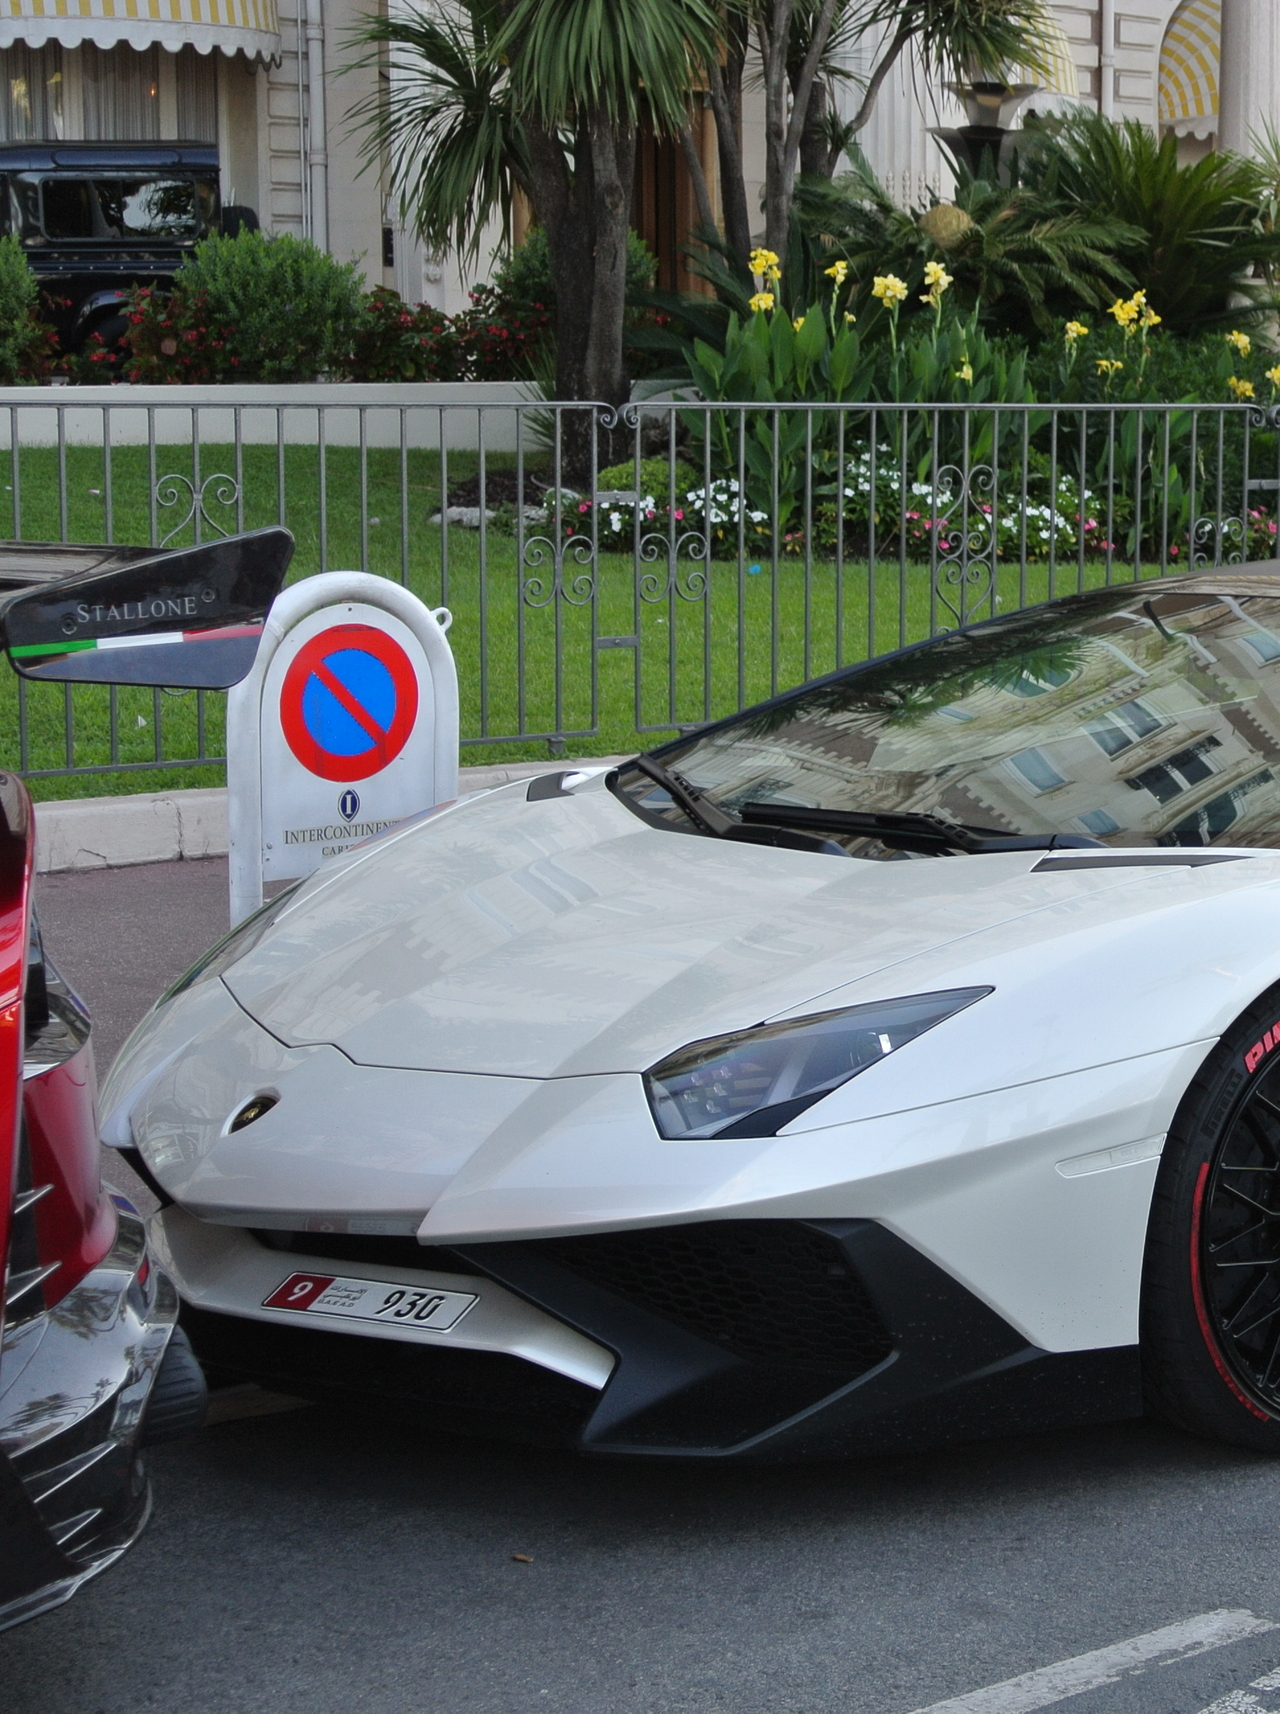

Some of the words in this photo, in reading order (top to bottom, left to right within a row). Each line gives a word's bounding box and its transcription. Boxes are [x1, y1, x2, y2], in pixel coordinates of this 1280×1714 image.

[77, 596, 198, 623] STALLONE
[286, 1281, 314, 1301] 9
[374, 1290, 446, 1321] 930
